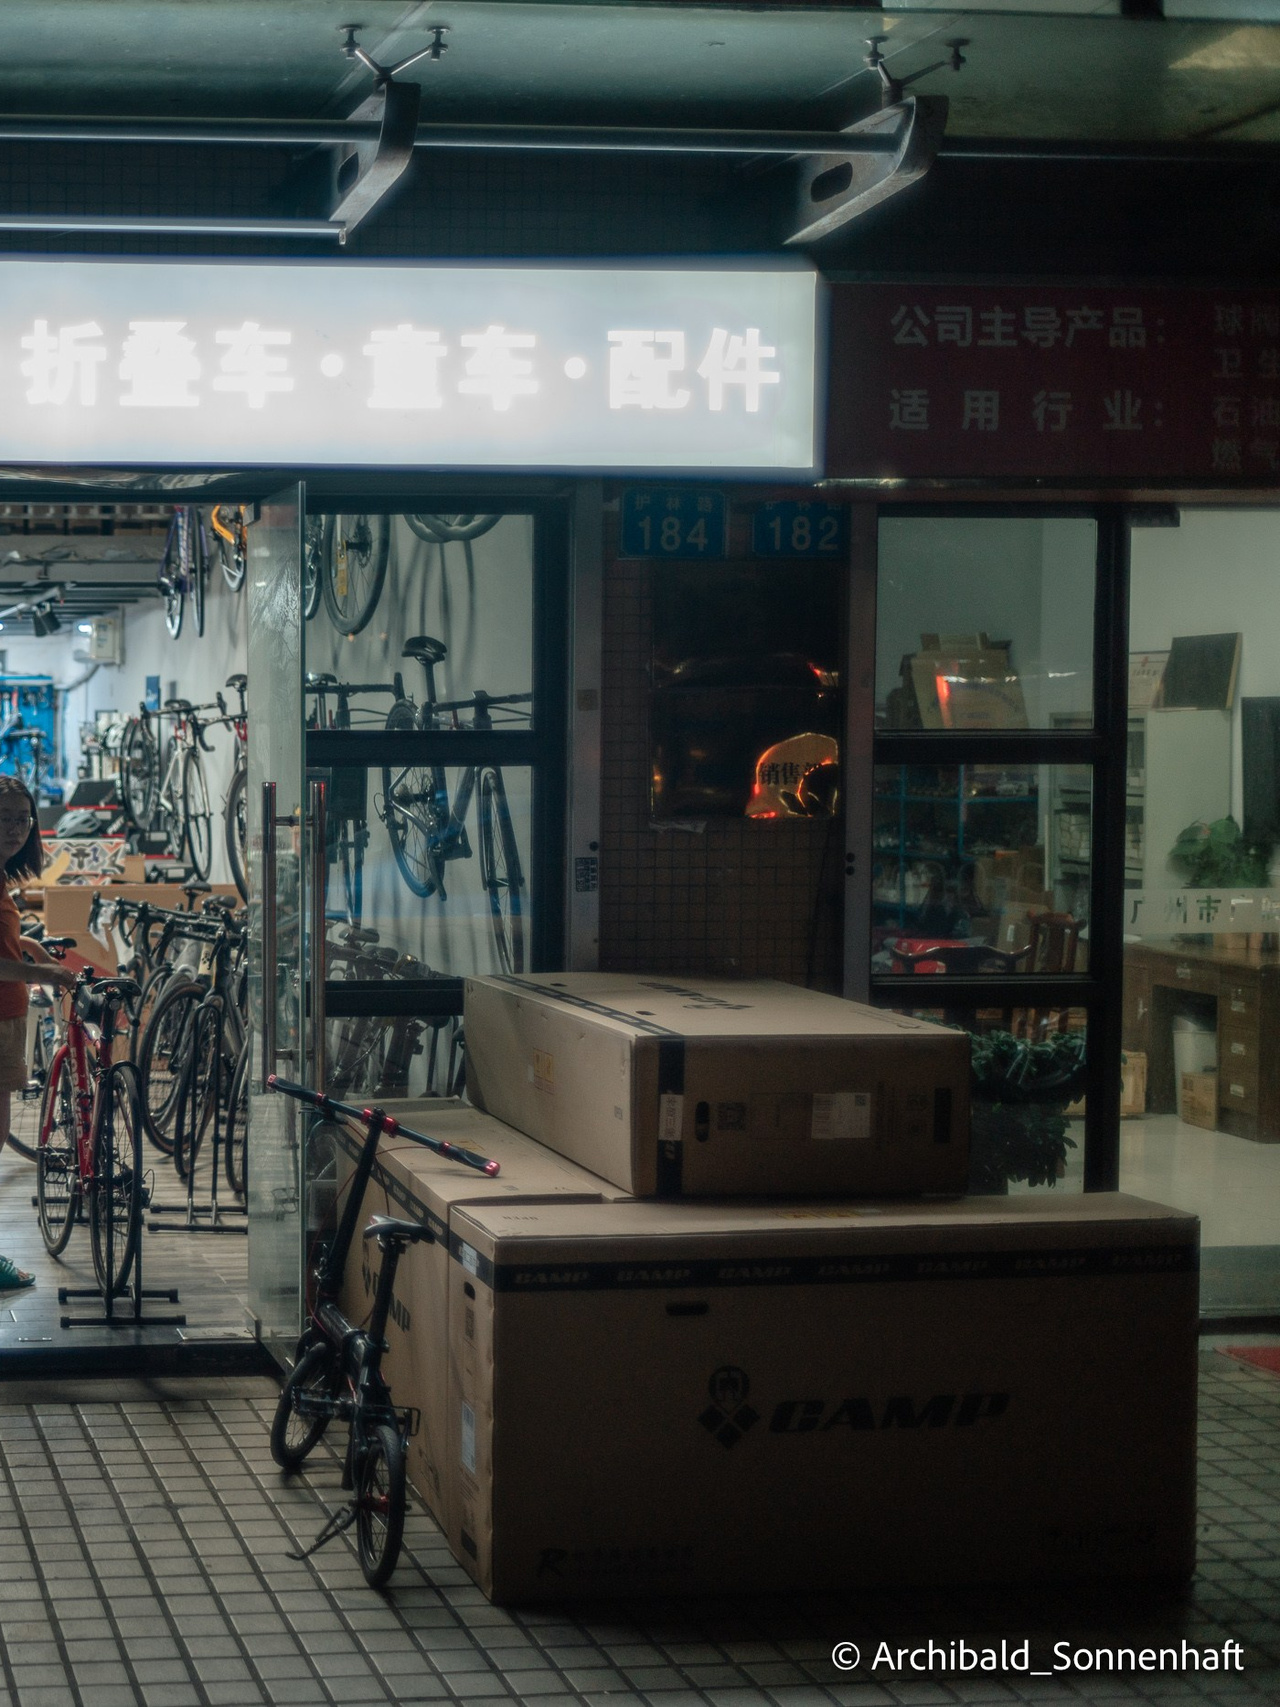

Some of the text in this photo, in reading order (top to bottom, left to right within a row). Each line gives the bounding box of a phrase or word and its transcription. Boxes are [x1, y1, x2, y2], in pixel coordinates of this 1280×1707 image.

[637, 515, 709, 552] 184
[768, 515, 839, 551] 182
[513, 1269, 589, 1286] CAMP
[616, 1266, 692, 1283] CAMP
[718, 1264, 792, 1281] CAMP
[817, 1261, 892, 1278] CAMP
[916, 1258, 988, 1275] CAMP
[1014, 1255, 1087, 1272] CAMP
[768, 1392, 1011, 1434] CAMP
